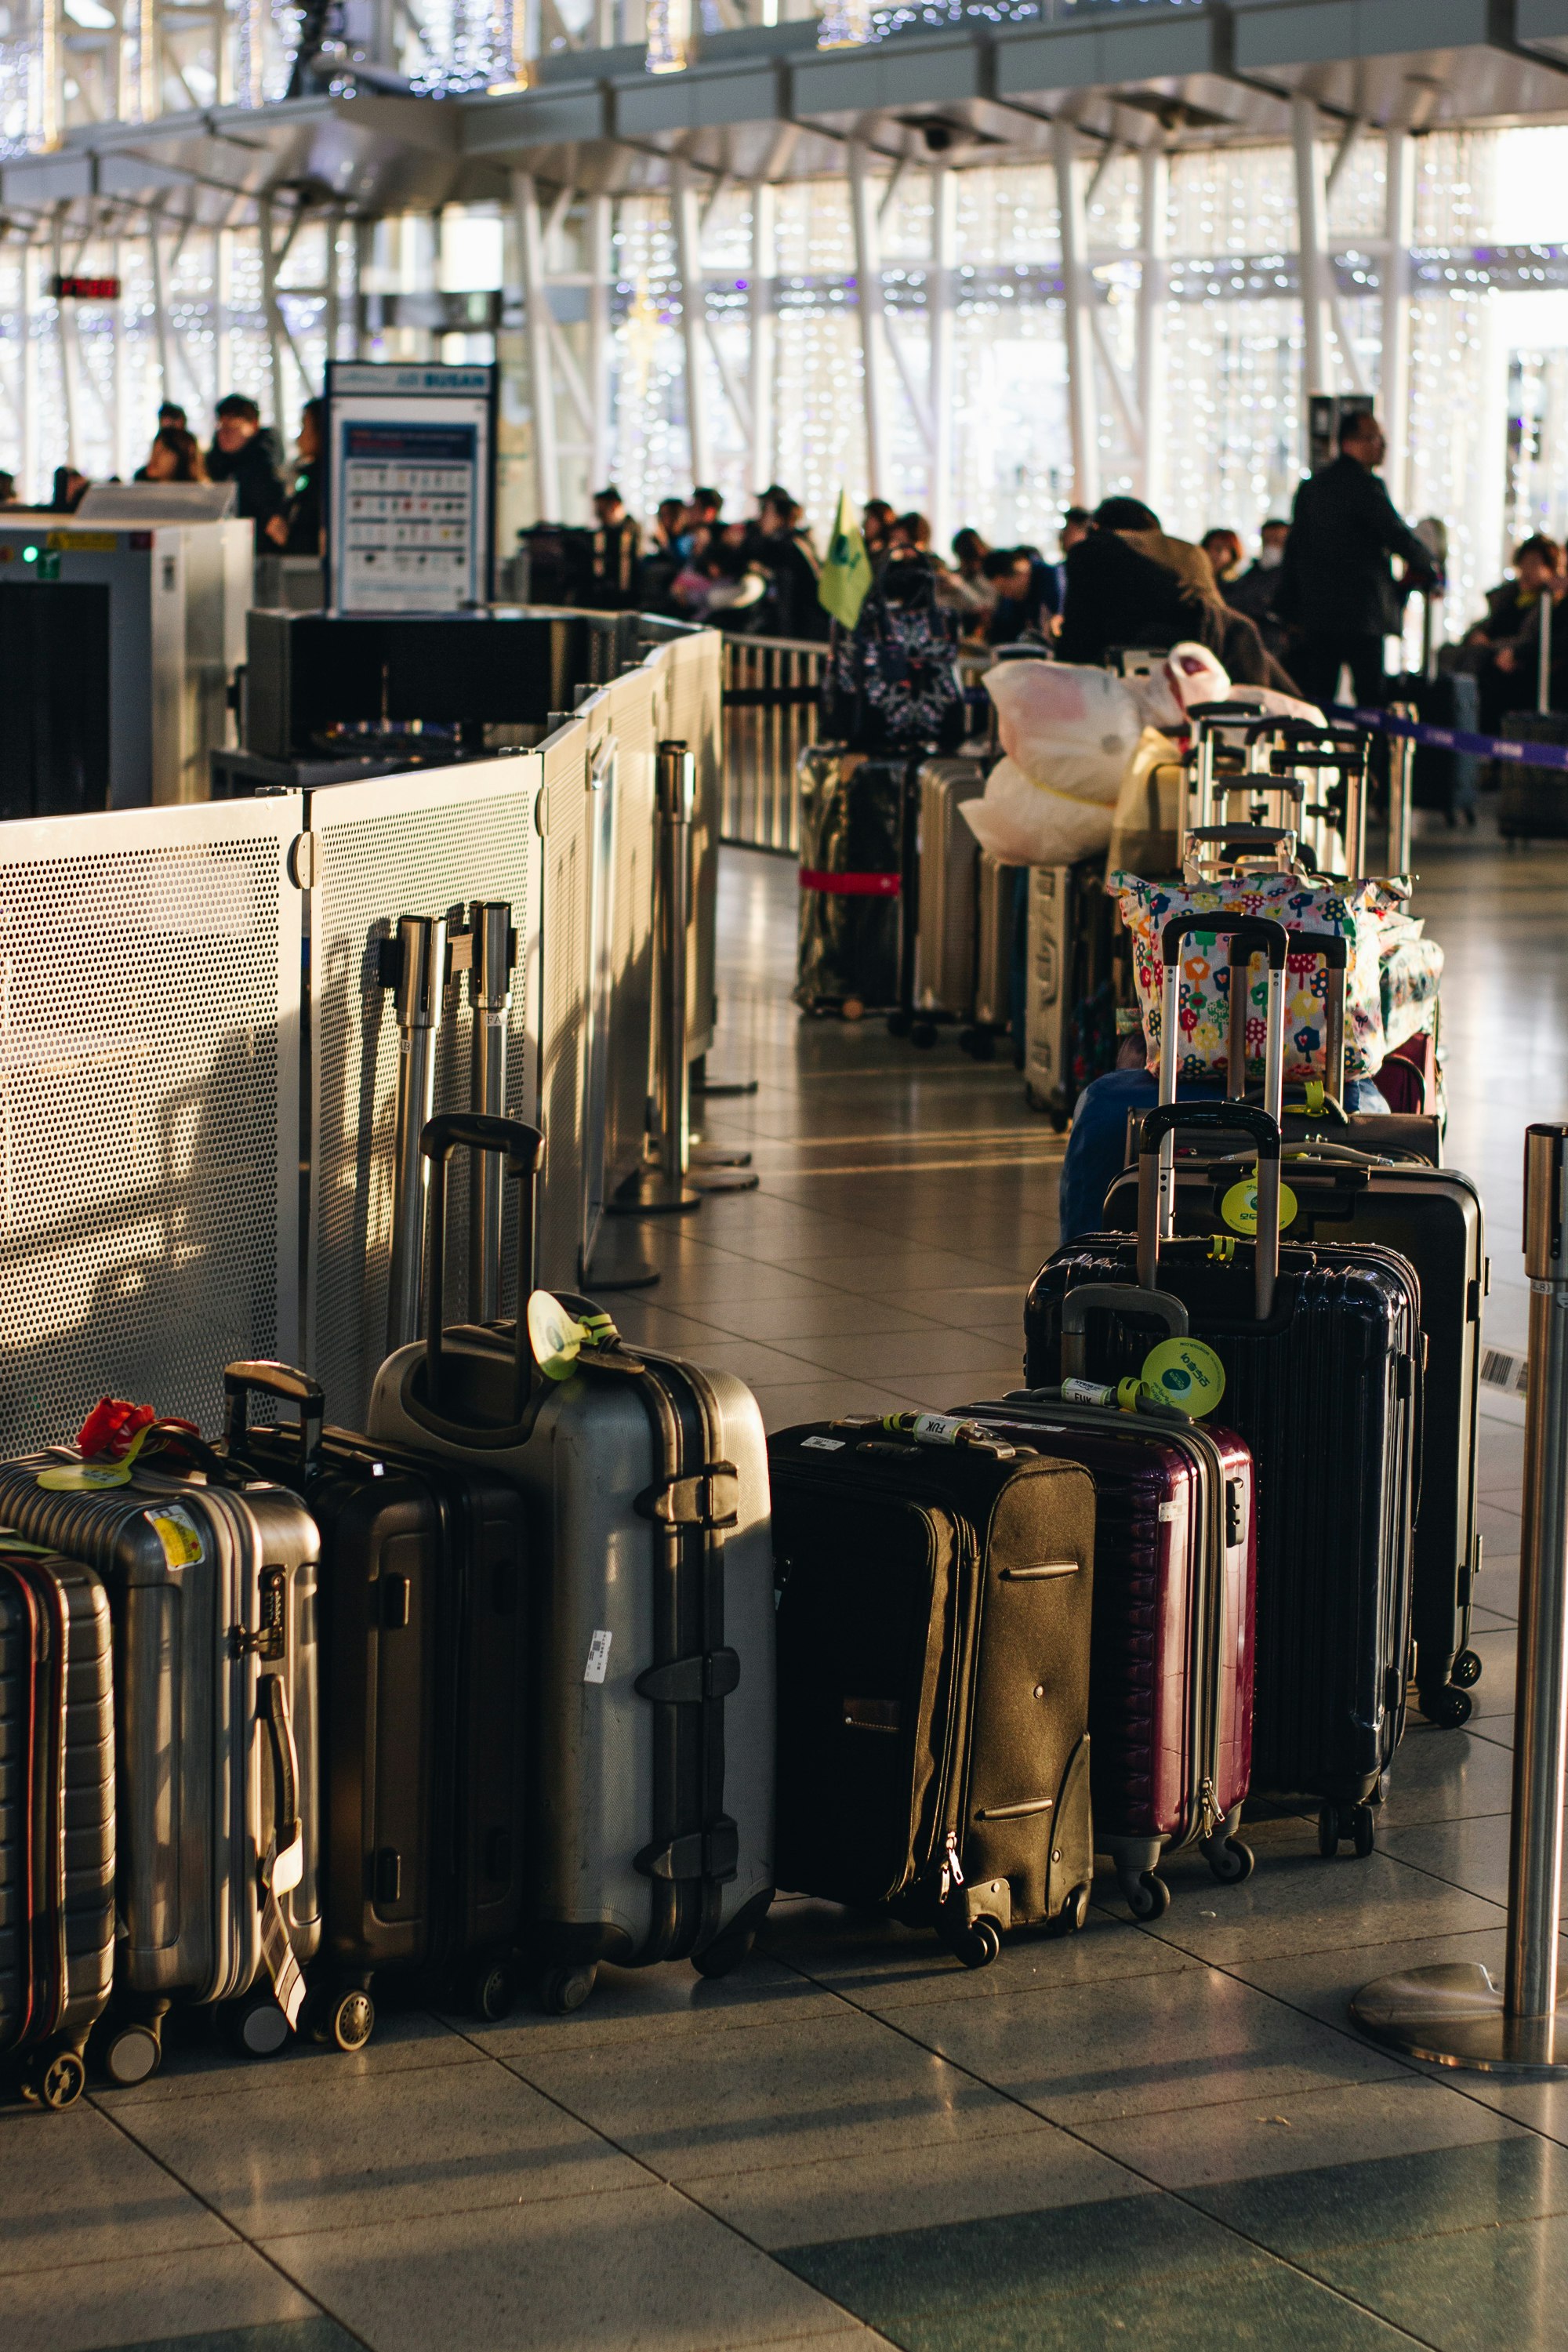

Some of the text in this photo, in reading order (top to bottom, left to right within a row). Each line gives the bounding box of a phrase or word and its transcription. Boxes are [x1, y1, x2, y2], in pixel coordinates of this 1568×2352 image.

[1180, 1352, 1210, 1388] 모두투어
[1074, 1380, 1094, 1388] BUSAN
[926, 1421, 946, 1433] FUK
